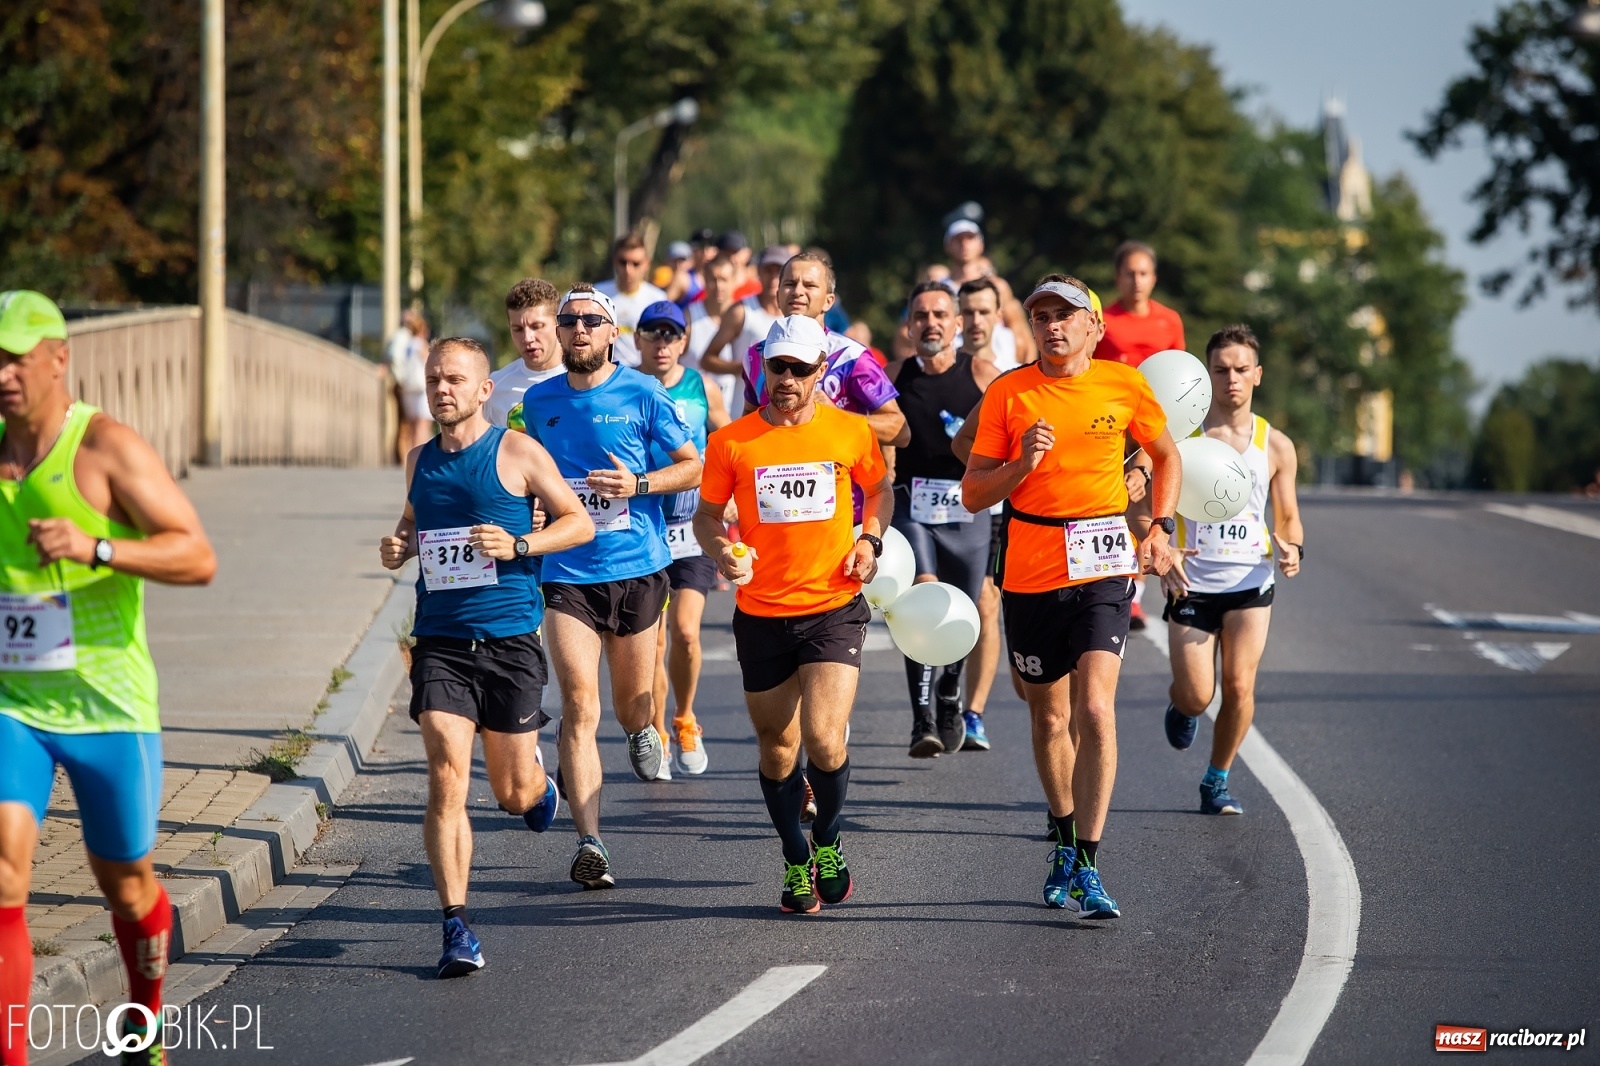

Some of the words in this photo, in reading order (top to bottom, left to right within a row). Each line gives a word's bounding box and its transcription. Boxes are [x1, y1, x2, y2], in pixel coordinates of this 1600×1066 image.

[780, 479, 817, 499] 407
[931, 492, 959, 506] 365
[1219, 524, 1247, 540] 140
[1091, 532, 1128, 554] 194
[438, 544, 475, 565] 378
[5, 614, 37, 640] 92
[1013, 650, 1044, 676] 88
